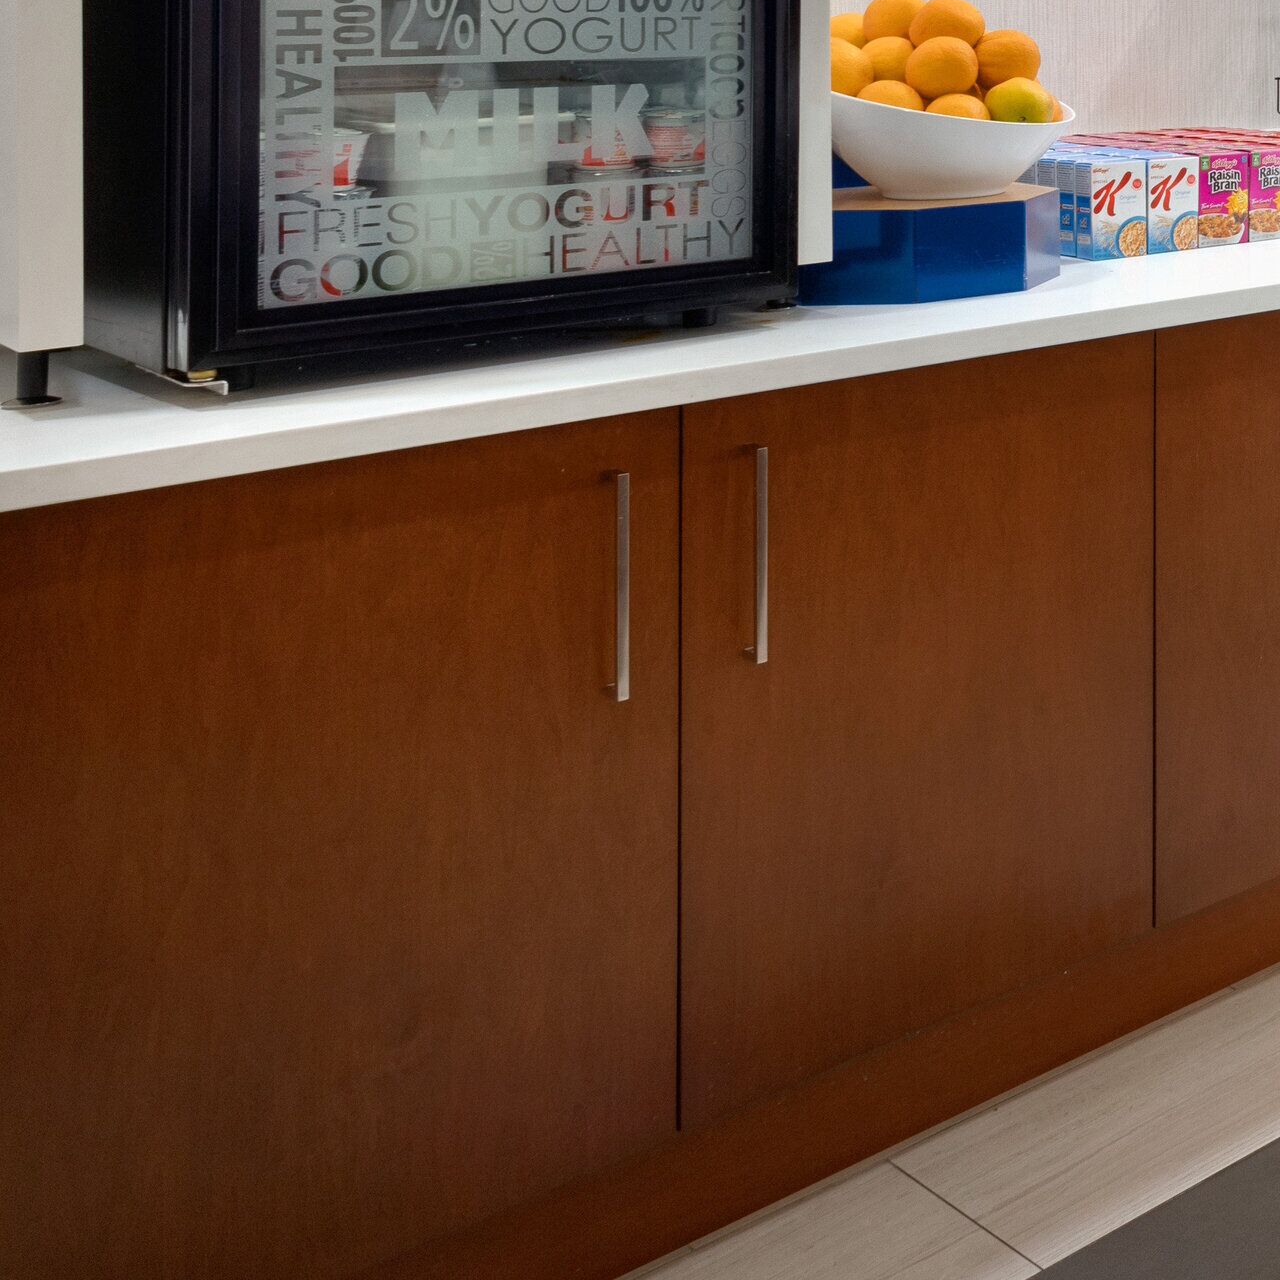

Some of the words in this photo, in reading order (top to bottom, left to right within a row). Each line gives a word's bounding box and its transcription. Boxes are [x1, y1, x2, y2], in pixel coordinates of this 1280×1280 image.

[490, 16, 701, 55] YOGURT
[394, 83, 654, 172] MILK
[1093, 171, 1133, 217] K
[1150, 167, 1189, 211] K
[1209, 171, 1241, 183] Raisin
[1212, 180, 1238, 192] Bran
[278, 200, 457, 255] FRESH
[464, 179, 710, 237] YOGURT
[523, 218, 745, 276] HEALTHY
[270, 246, 463, 303] GOOD
